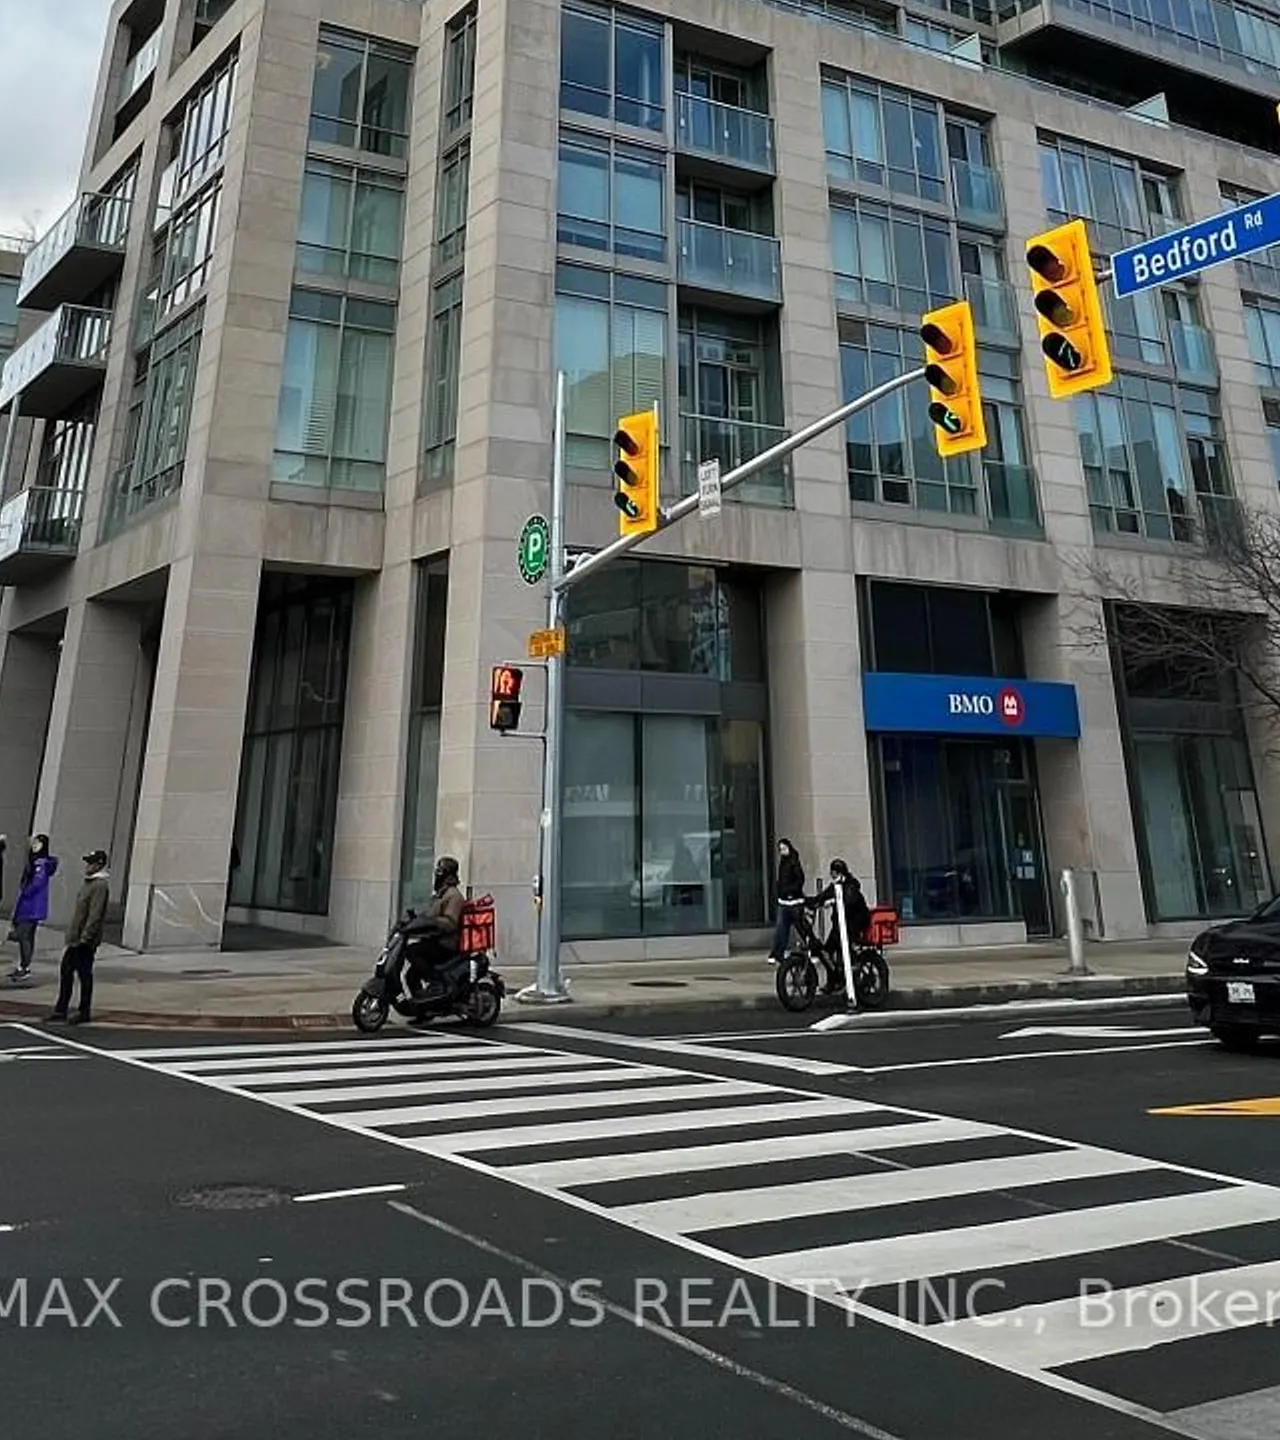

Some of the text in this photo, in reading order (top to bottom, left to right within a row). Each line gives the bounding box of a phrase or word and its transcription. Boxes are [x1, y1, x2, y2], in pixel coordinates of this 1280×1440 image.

[1133, 210, 1263, 282] Bedford Rd
[528, 532, 541, 561] P
[948, 694, 993, 715] BMO
